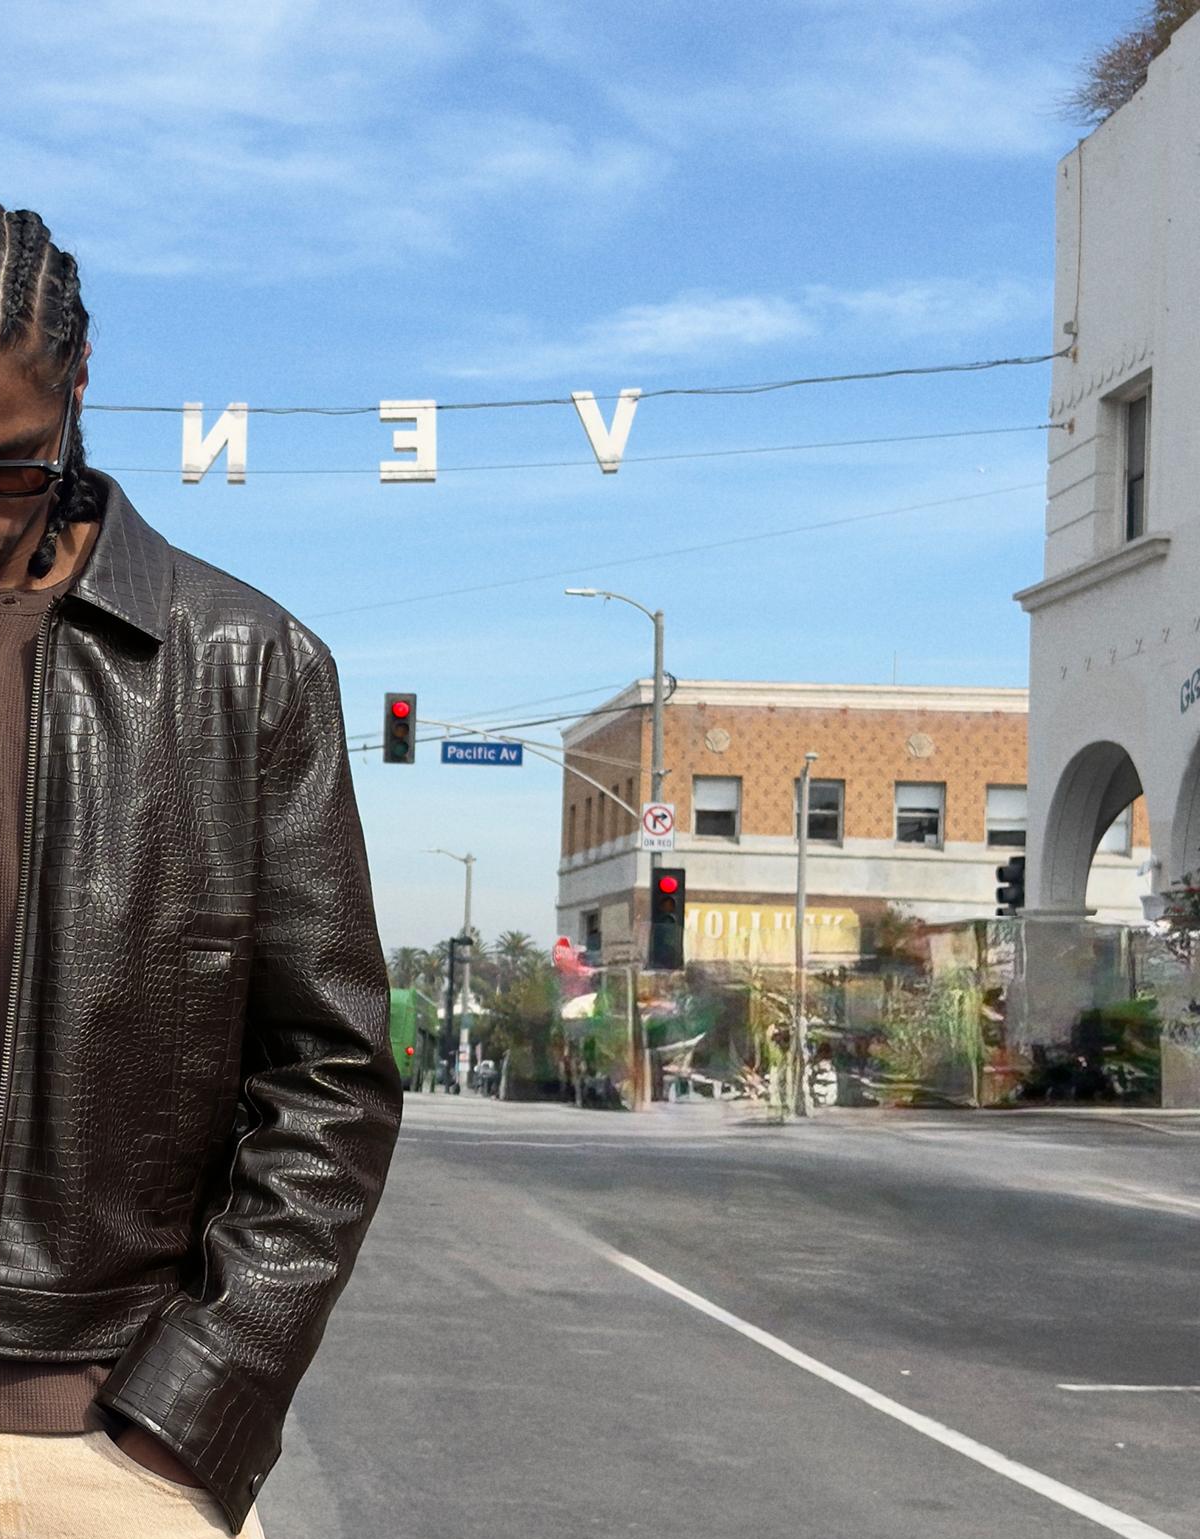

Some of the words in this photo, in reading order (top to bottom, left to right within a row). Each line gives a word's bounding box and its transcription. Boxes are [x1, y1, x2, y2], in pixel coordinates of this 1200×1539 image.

[447, 745, 497, 761] Pacific
[499, 746, 518, 761] Av
[643, 838, 655, 847] ON
[657, 839, 672, 848] RED
